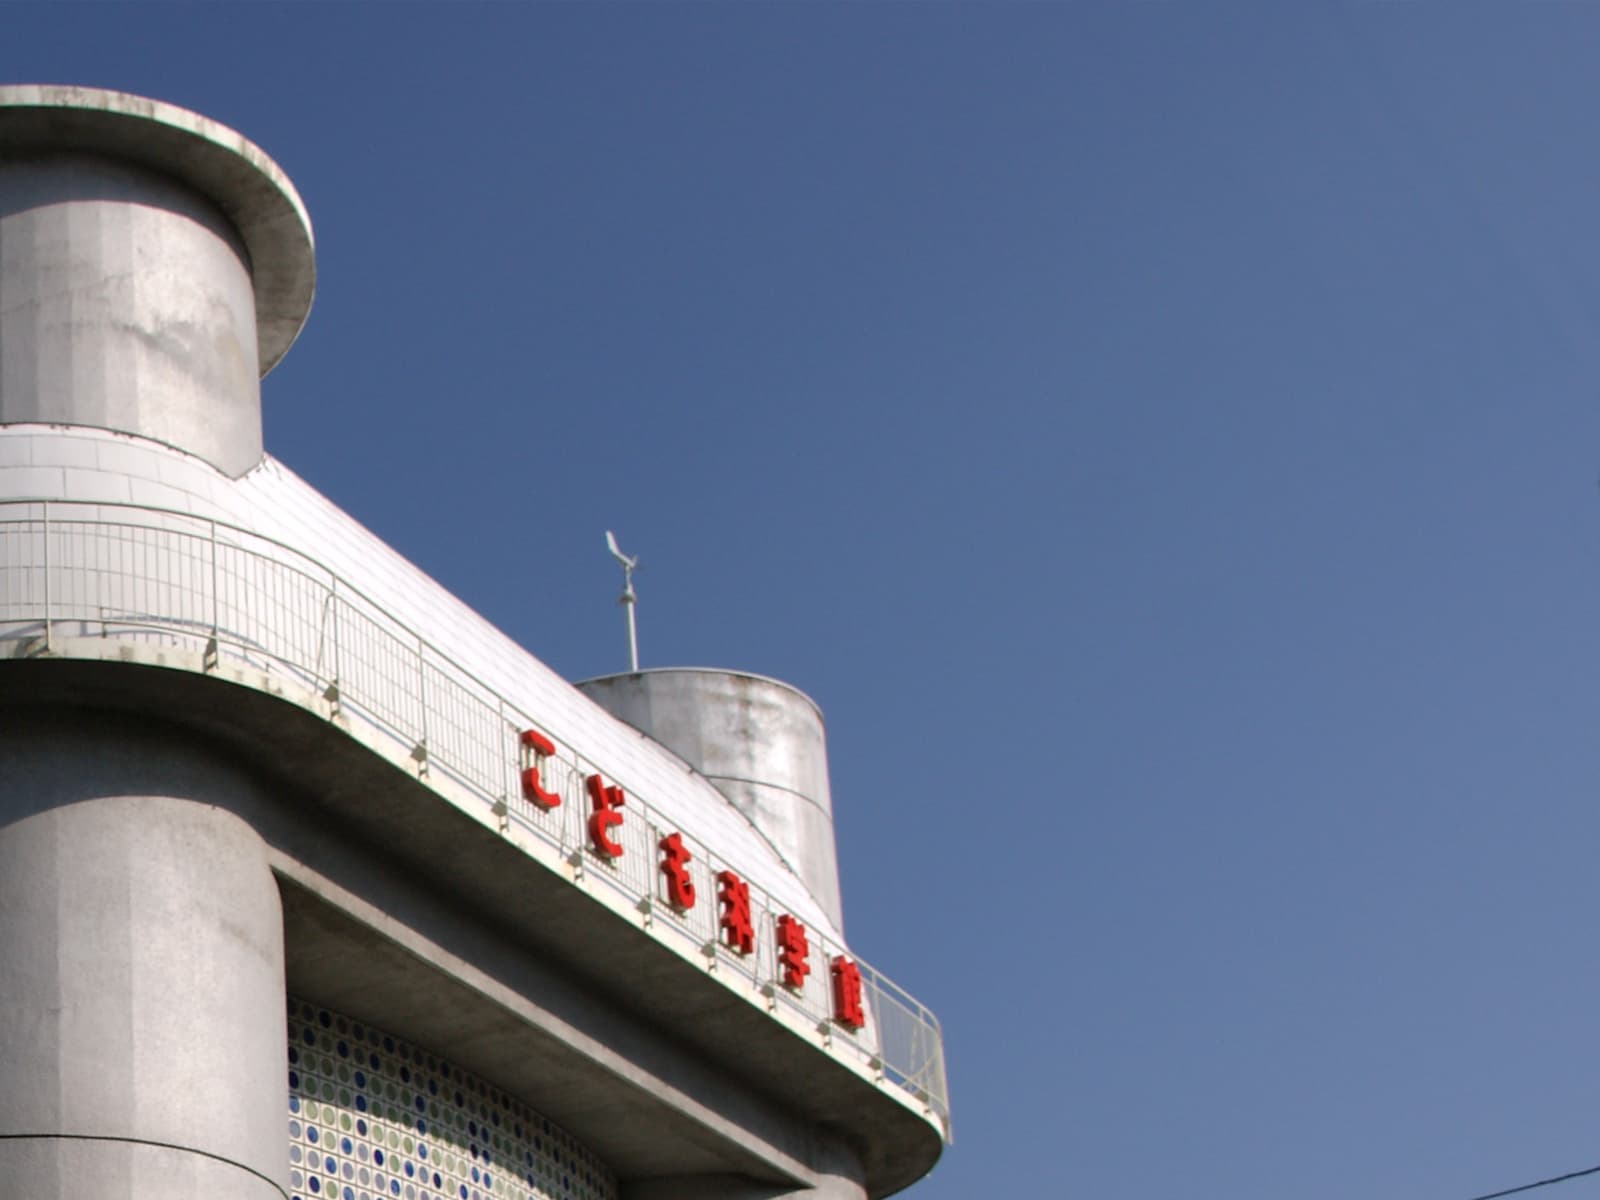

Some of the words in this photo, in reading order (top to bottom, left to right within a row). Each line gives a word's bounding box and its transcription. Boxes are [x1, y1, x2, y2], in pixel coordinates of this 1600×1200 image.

[520, 729, 864, 1034] こども科学館
